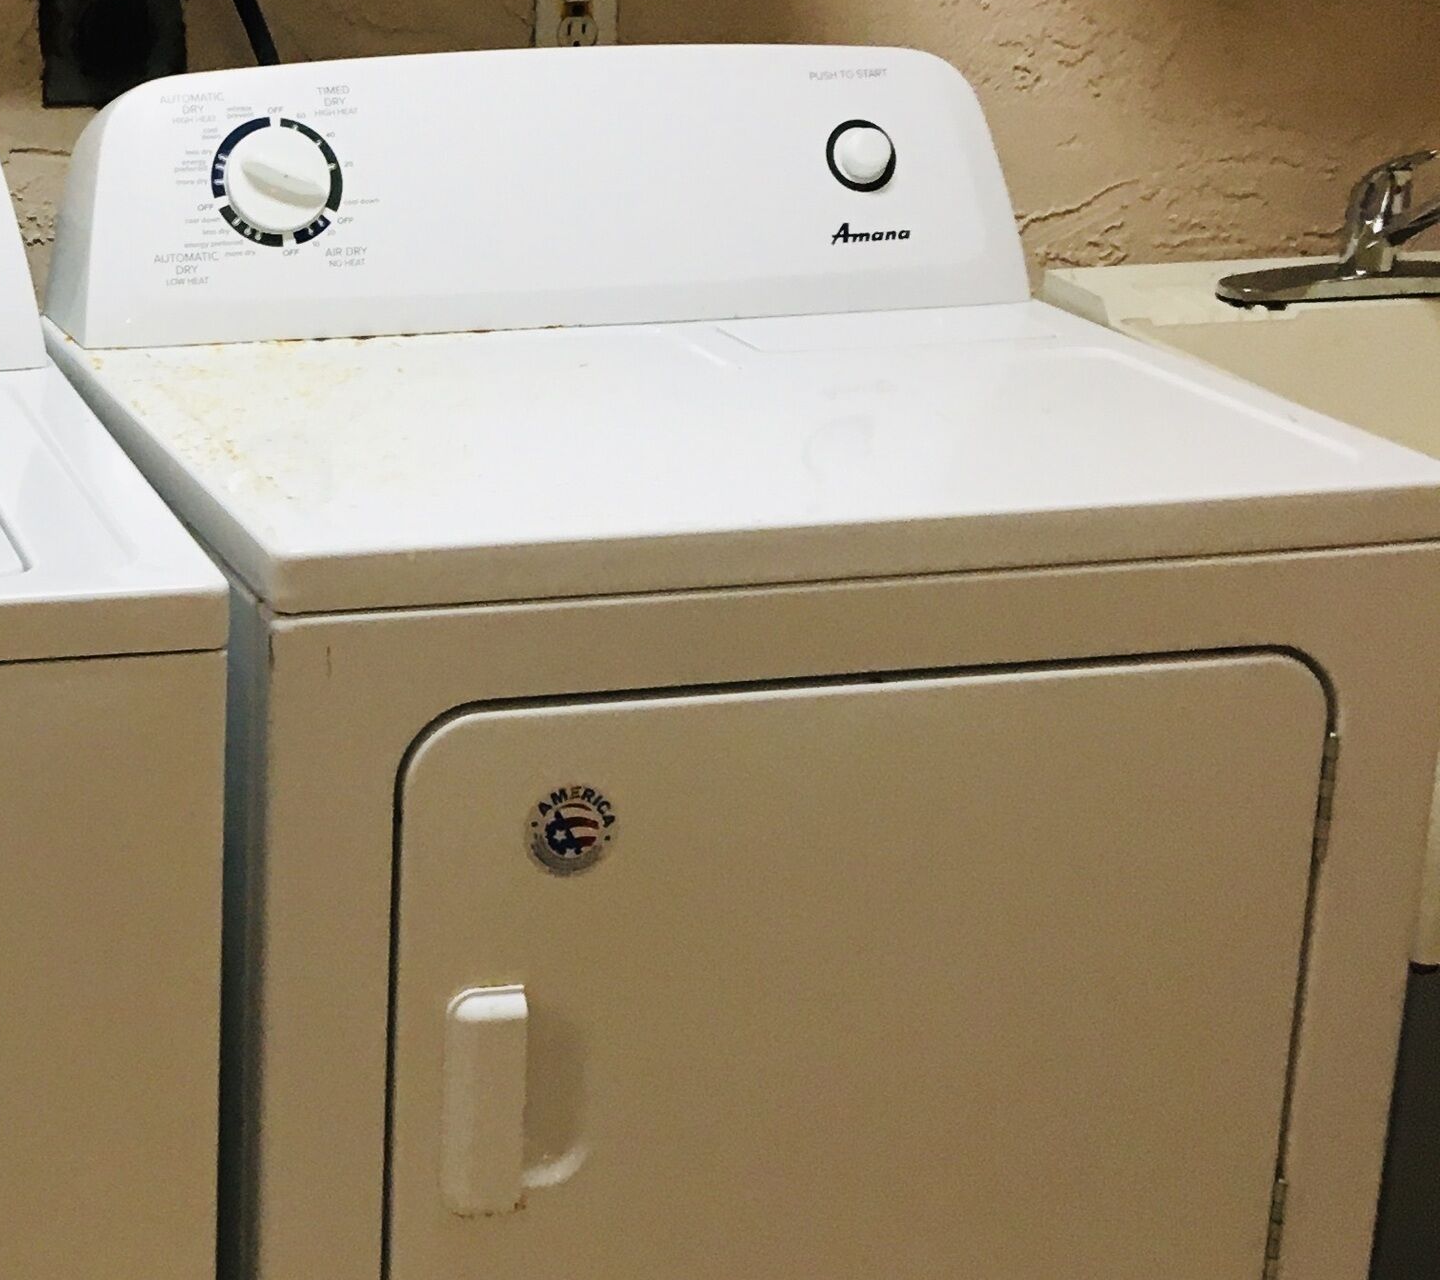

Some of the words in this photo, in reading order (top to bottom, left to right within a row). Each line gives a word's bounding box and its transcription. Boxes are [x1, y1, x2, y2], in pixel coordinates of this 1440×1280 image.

[808, 71, 838, 81] PUSH
[839, 70, 855, 80] TO
[855, 68, 888, 80] START
[316, 85, 351, 96] TIMED
[159, 91, 225, 104] AUTOMATIC
[323, 97, 347, 107] DRY
[182, 104, 205, 116] DRY
[267, 106, 284, 115] OFF
[197, 204, 214, 212] OFF
[336, 216, 355, 225] OFF
[831, 222, 911, 246] Amana
[153, 251, 220, 264] AUTOMATIC
[282, 248, 301, 257] OFF
[324, 248, 343, 258] AIR
[345, 246, 368, 257] DRY
[175, 265, 199, 276] DRY
[537, 785, 616, 829] AMERICA
